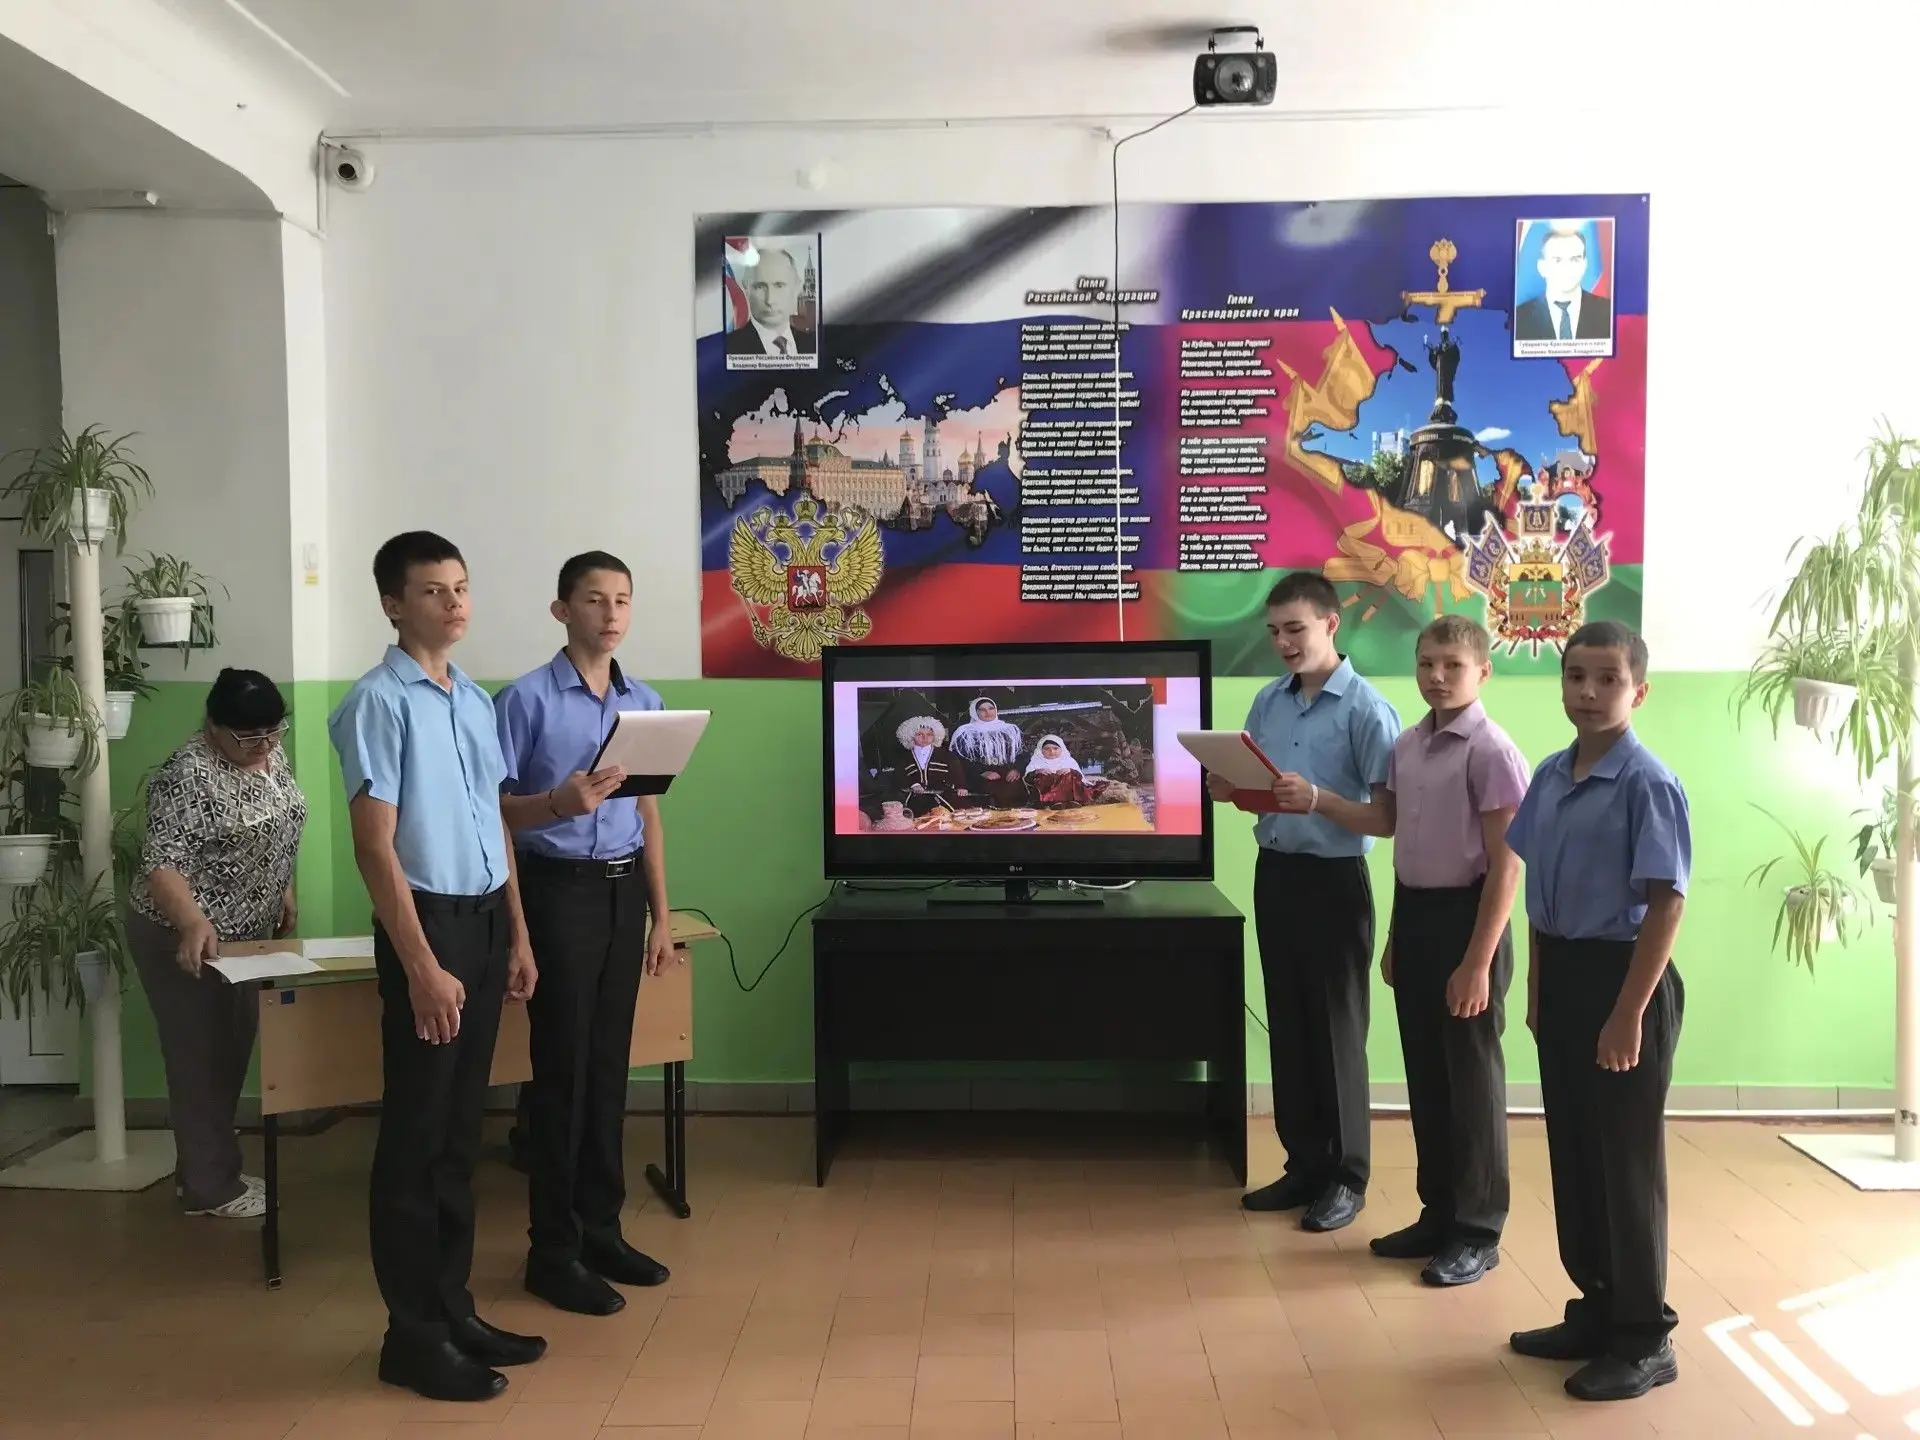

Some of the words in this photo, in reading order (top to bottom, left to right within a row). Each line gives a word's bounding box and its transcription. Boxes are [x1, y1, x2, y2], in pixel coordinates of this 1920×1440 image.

[1079, 279, 1105, 288] Гимн
[1028, 292, 1091, 302] Российской
[1227, 294, 1253, 304] Гимн
[1182, 309, 1270, 320] Краснодарского
[1274, 308, 1299, 318] края
